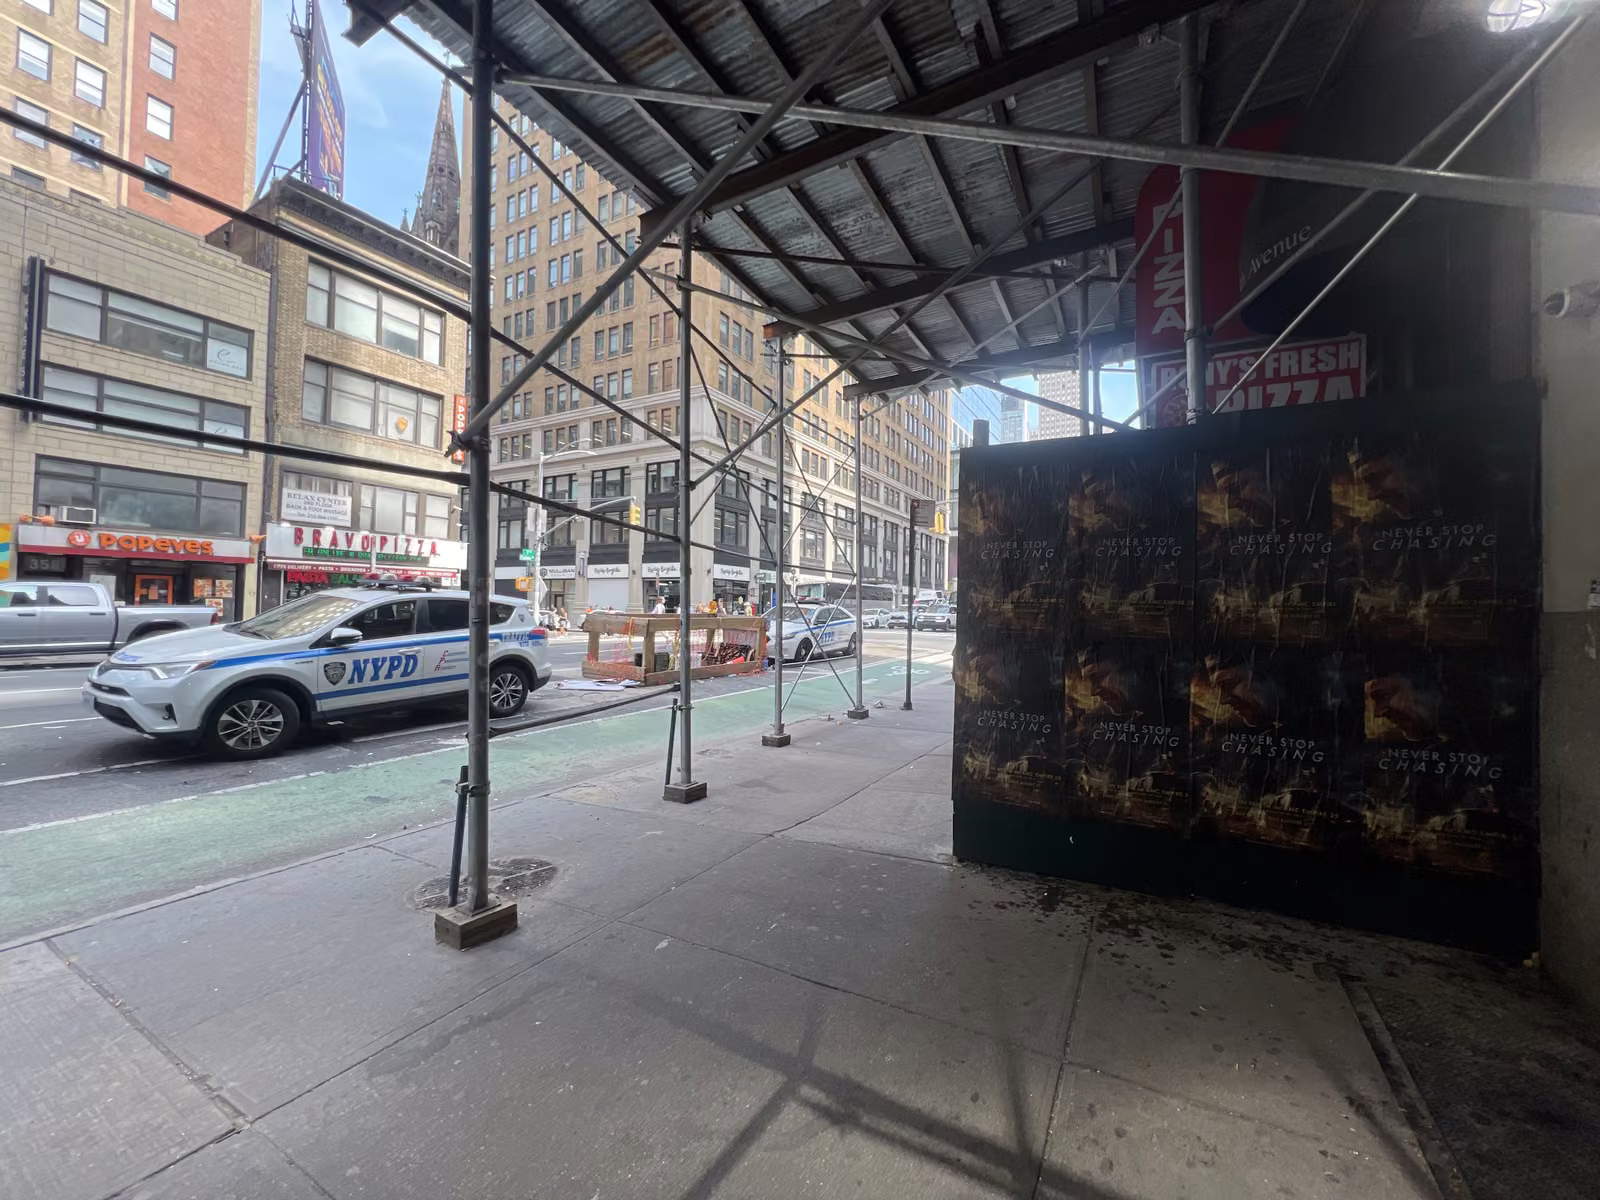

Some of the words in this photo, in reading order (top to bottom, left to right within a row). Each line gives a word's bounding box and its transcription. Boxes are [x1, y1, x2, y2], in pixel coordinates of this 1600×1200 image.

[1248, 225, 1311, 280] Avenue
[1152, 200, 1185, 335] PIZZA
[1265, 341, 1360, 379] FRESH
[1238, 534, 1281, 544] NEVER
[1288, 533, 1324, 543] STOP
[1382, 526, 1433, 538] NEVER
[1442, 523, 1485, 536] STOP
[294, 527, 370, 551] BRAVO
[380, 535, 438, 556] PIZZA
[986, 541, 1018, 550] NEVER
[1022, 540, 1048, 549] STOP
[1102, 538, 1139, 547] NEVER
[1145, 536, 1175, 546] STOP
[1230, 542, 1333, 555] CHASING
[1372, 534, 1497, 551] CHASING
[980, 548, 1055, 560] CHASING
[1095, 546, 1182, 557] CHASING
[347, 655, 419, 684] NYPD
[983, 709, 1016, 720] NEVER
[1019, 713, 1046, 723] STOP
[977, 716, 1051, 734] CHASING
[1100, 721, 1137, 732] NEVER
[1142, 725, 1172, 735] STOP
[1093, 730, 1180, 747] CHASING
[1230, 733, 1273, 746] NEVER
[1280, 737, 1316, 750] STOP
[1221, 742, 1326, 763] CHASING
[1388, 748, 1441, 760] NEVER
[1378, 758, 1503, 779] CHASING
